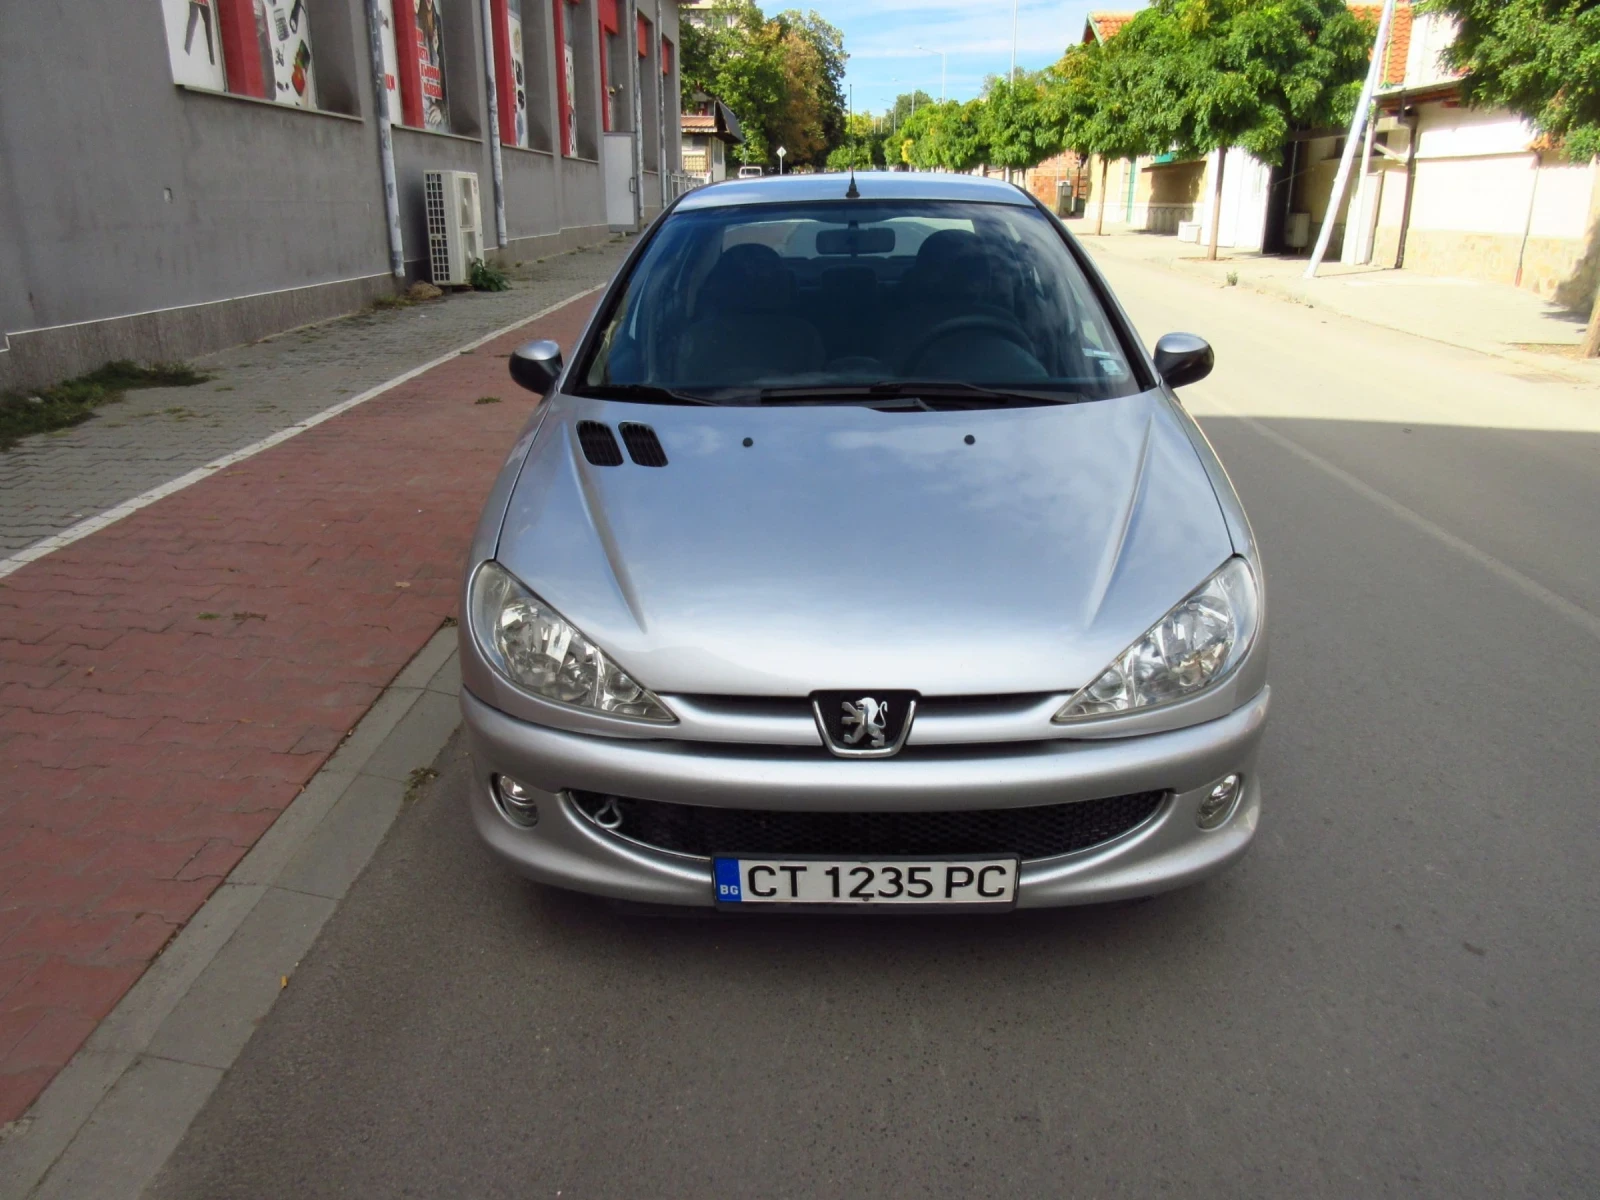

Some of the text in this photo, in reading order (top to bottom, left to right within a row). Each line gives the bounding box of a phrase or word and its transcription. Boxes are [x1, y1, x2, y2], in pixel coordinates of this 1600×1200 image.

[720, 884, 739, 895] BG
[747, 865, 1007, 898] CT 1235 PC
